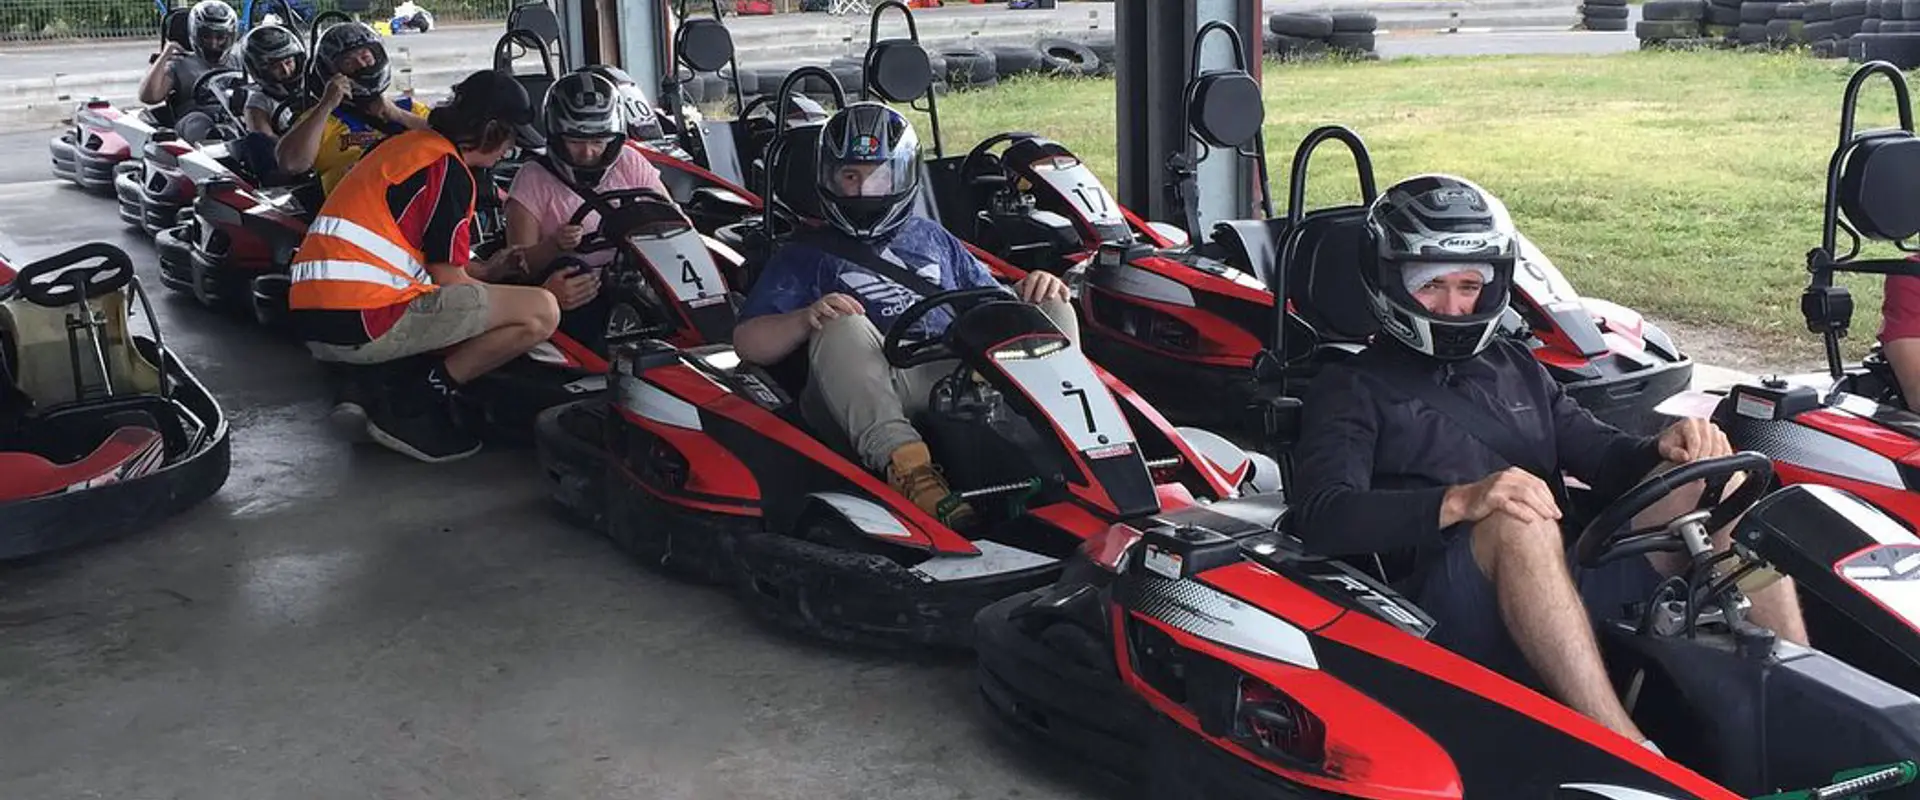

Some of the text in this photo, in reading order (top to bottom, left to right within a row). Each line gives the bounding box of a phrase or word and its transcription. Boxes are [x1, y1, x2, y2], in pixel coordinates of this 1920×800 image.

[624, 100, 651, 118] 10
[1071, 186, 1107, 213] 17
[682, 260, 704, 290] 4
[1062, 388, 1097, 433] 7
